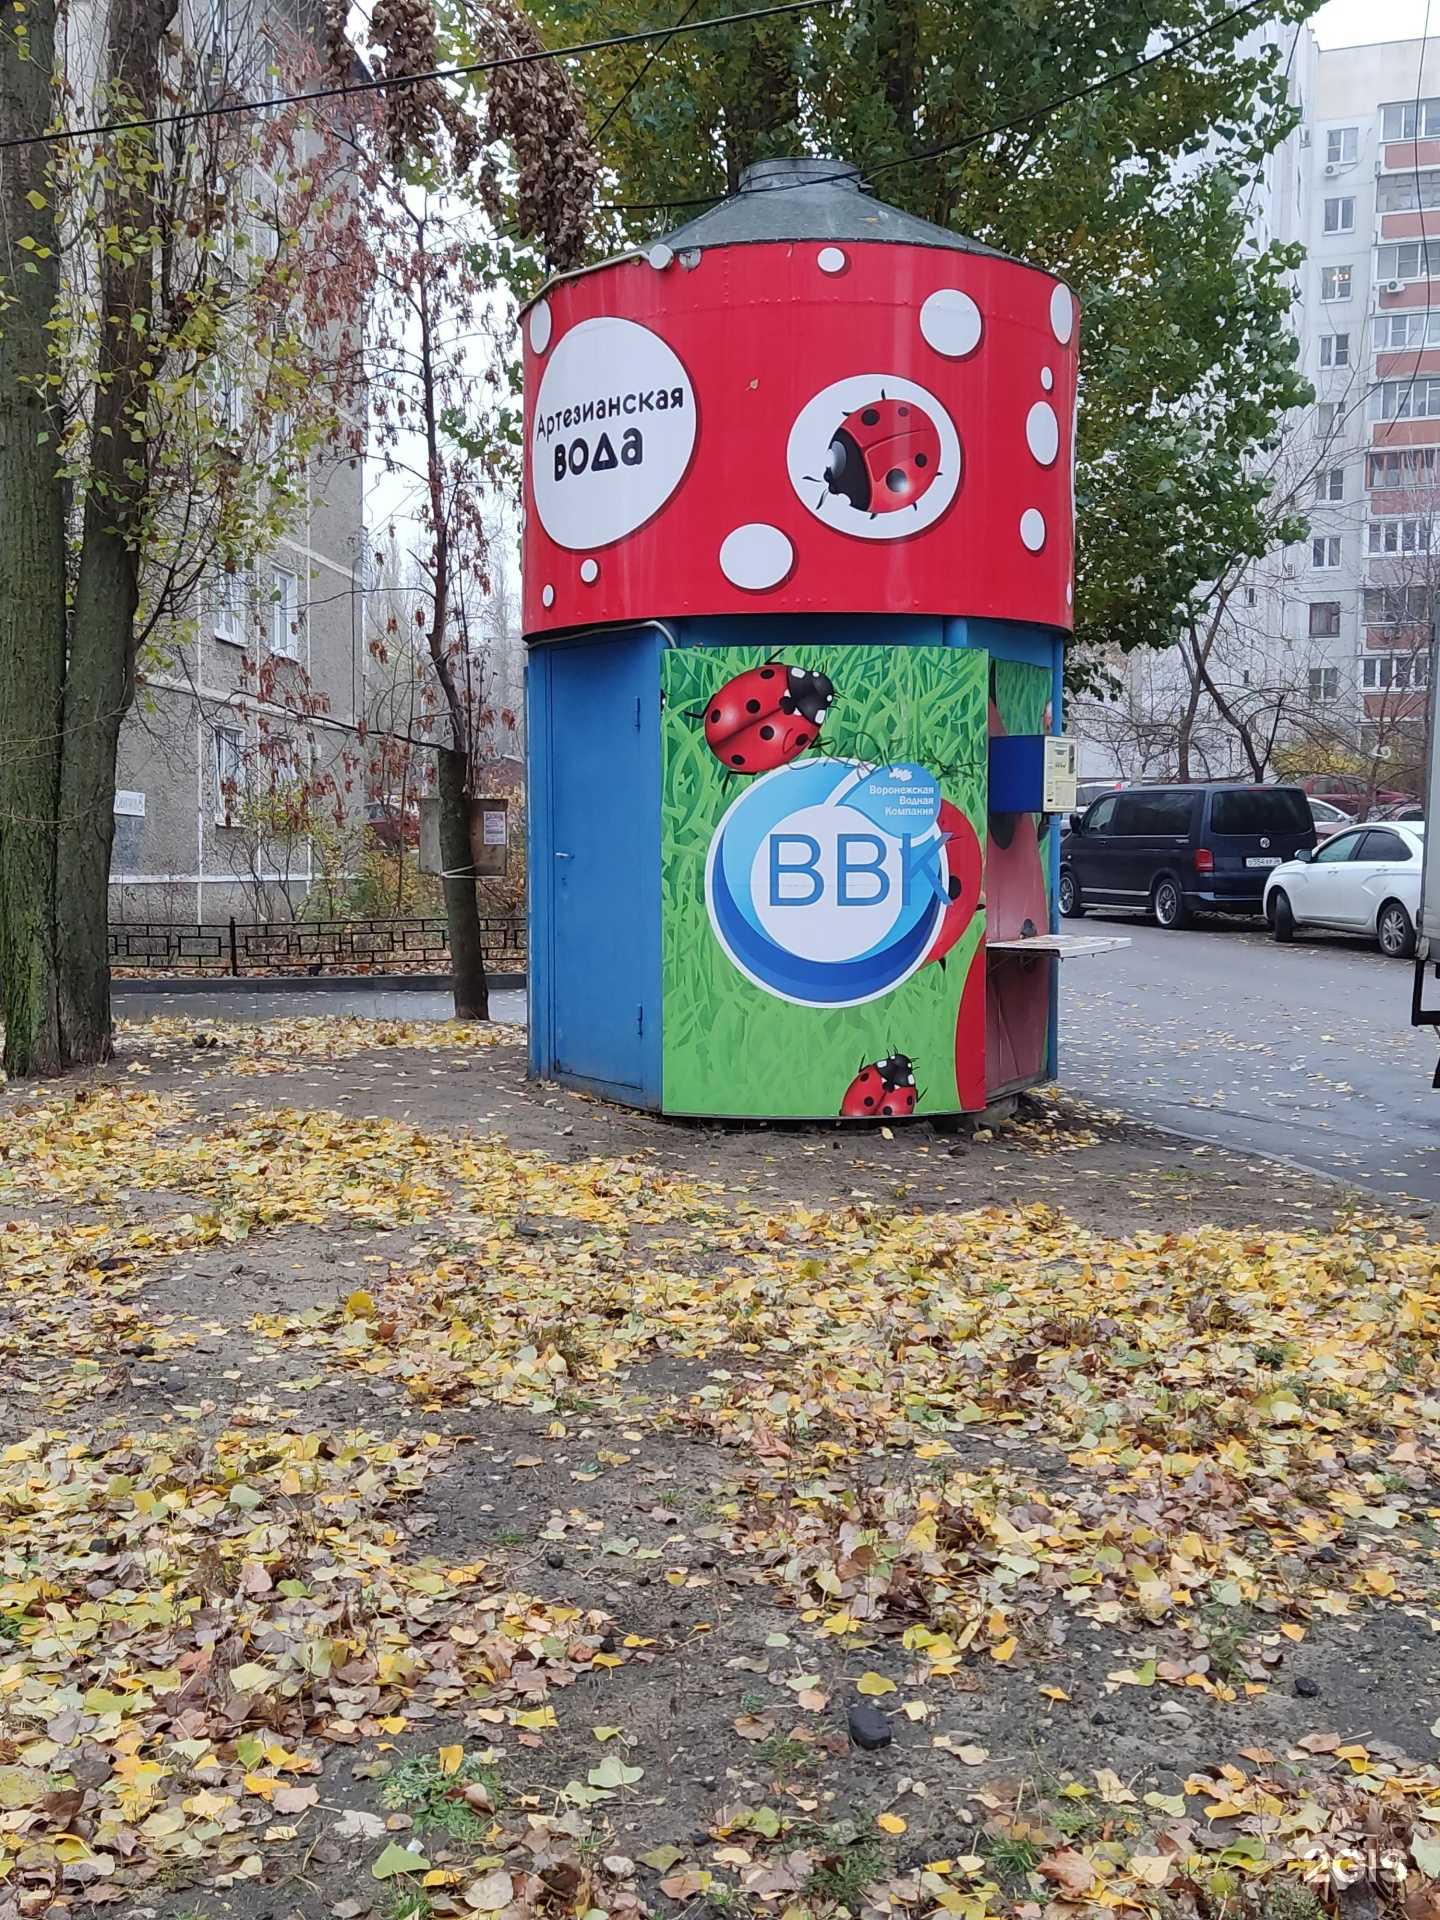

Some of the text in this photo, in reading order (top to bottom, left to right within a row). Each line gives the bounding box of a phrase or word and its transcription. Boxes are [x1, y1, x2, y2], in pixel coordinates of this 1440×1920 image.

[536, 387, 684, 443] Артезианская
[869, 784, 935, 795] Воронежская
[899, 795, 935, 806] Водная
[885, 806, 935, 816] Компания
[769, 832, 953, 907] ВВК
